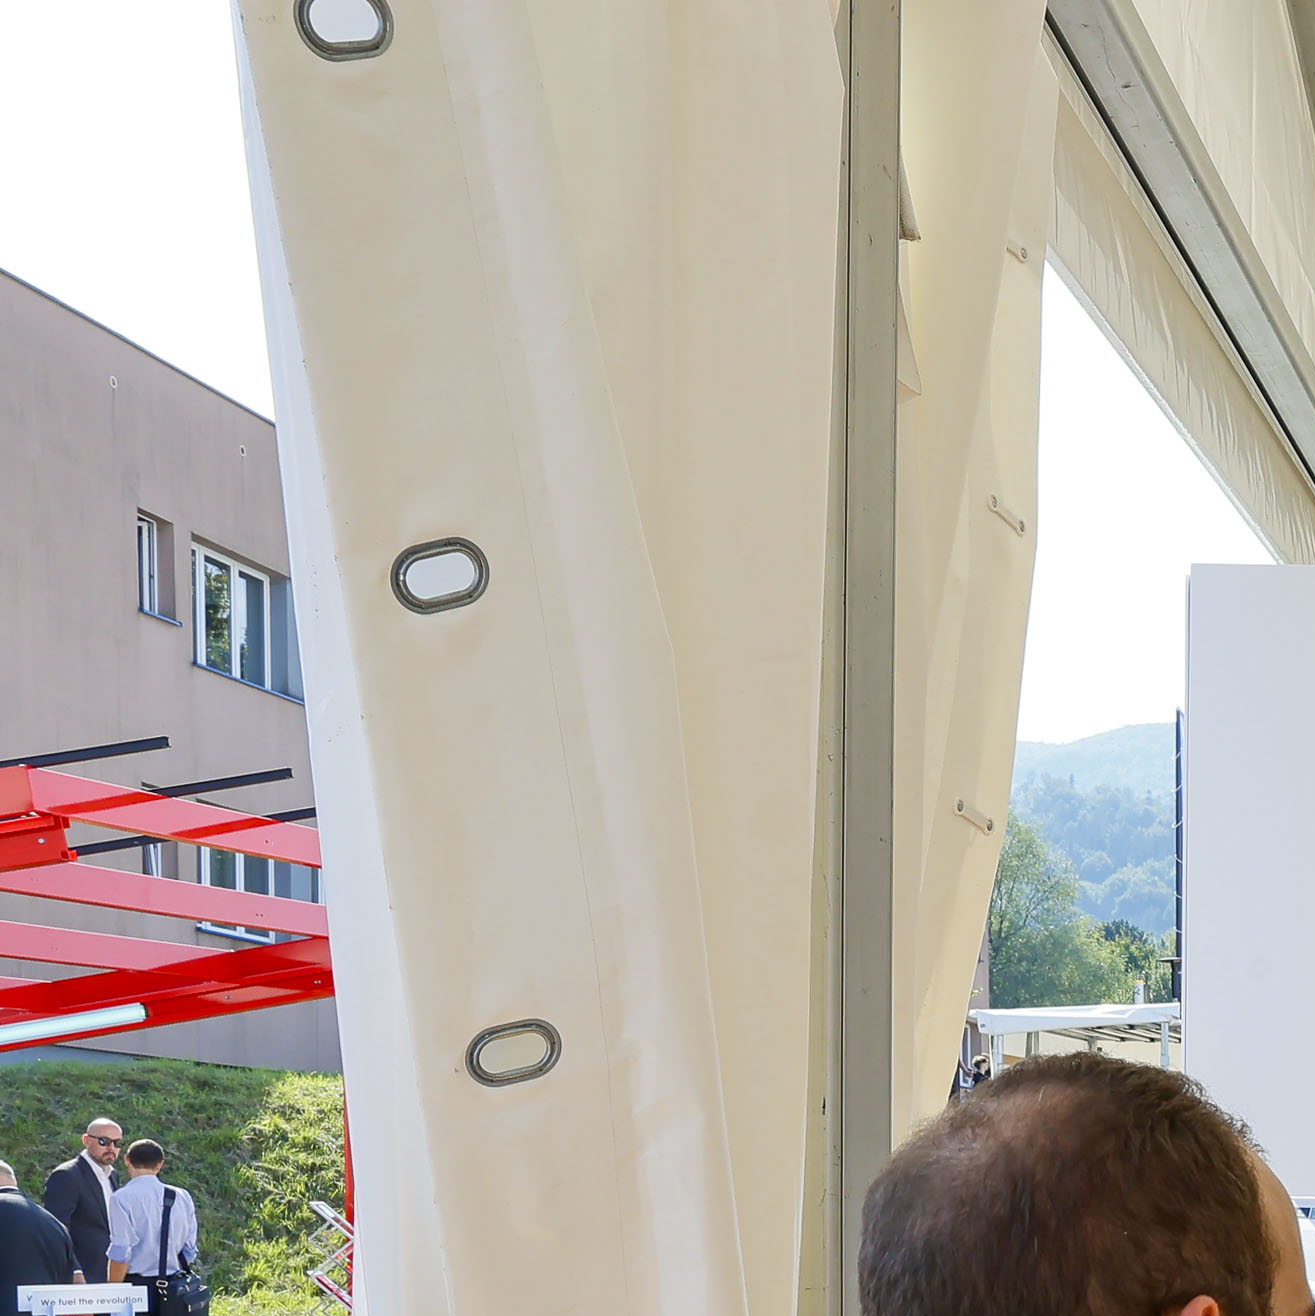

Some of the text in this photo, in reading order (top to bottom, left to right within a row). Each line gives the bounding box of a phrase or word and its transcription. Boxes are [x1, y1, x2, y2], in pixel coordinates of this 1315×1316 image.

[58, 1297, 77, 1306] fuel
[79, 1297, 93, 1305] the
[96, 1296, 143, 1305] revolution
